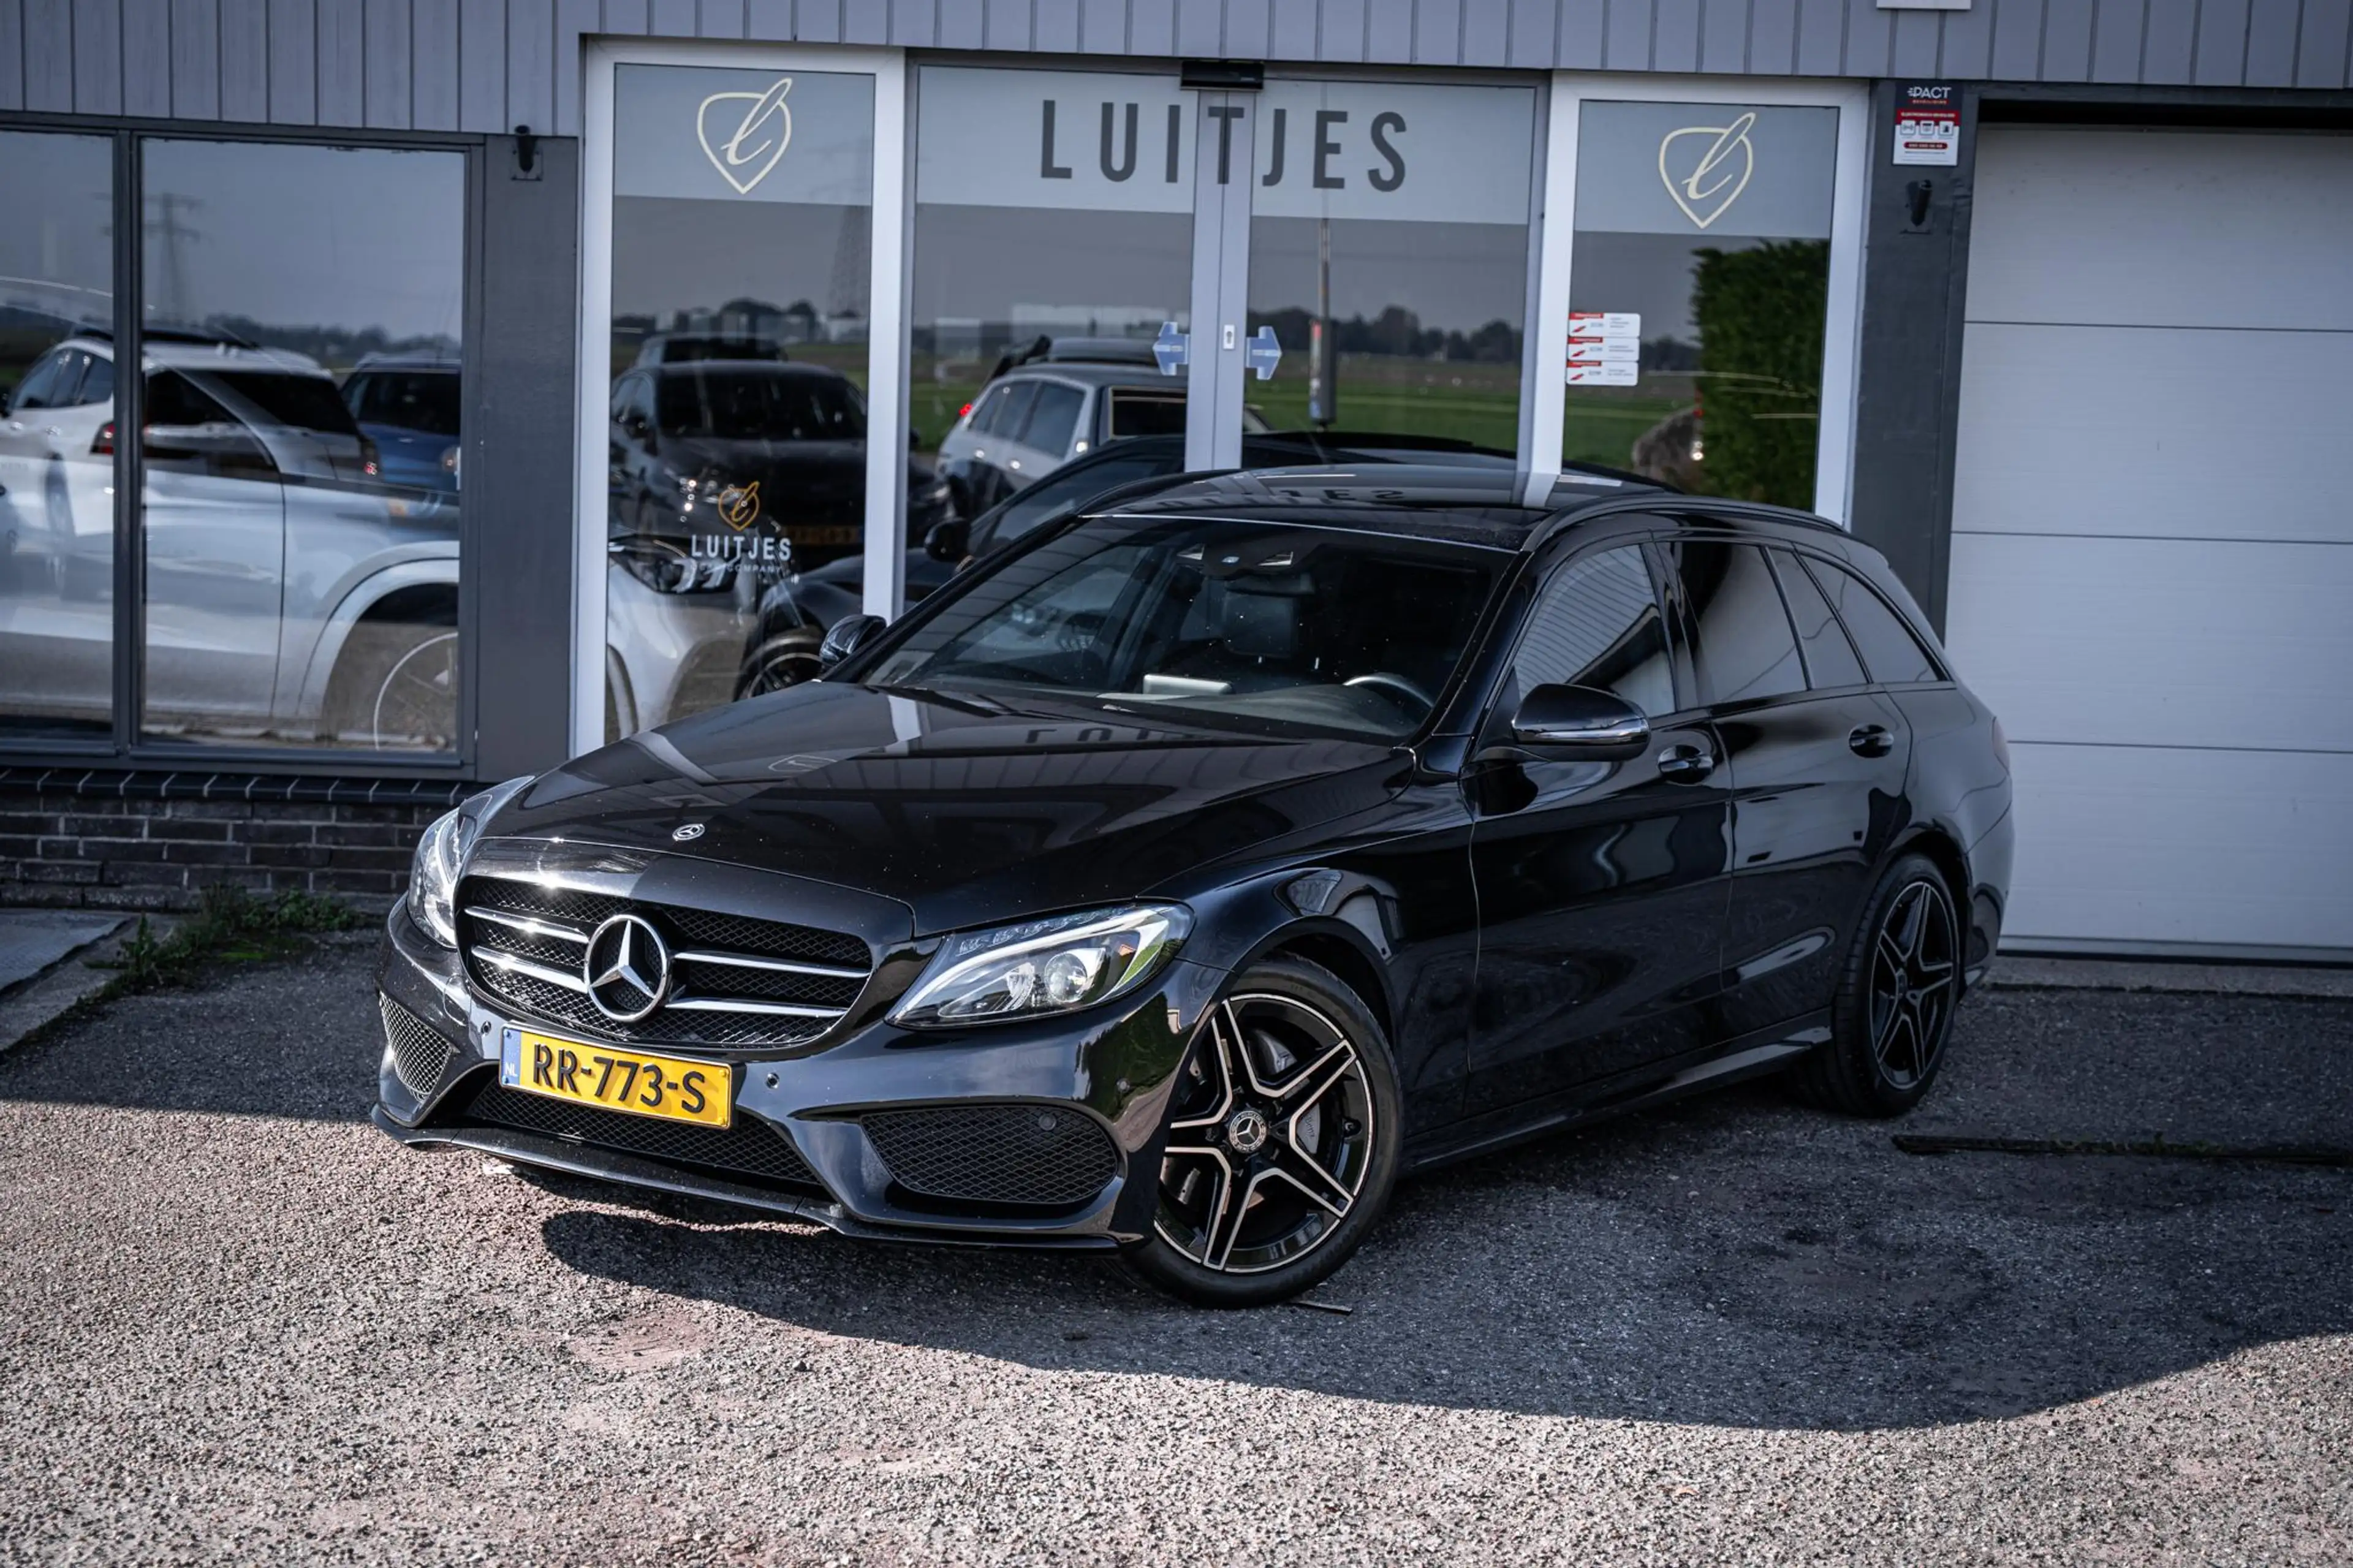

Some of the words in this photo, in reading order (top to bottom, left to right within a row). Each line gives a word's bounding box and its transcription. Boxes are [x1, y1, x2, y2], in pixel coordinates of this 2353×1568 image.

[1040, 99, 1407, 192] LUITJES
[691, 534, 792, 561] LUITJES
[505, 1062, 517, 1078] NL
[533, 1043, 706, 1114] RR-773-S
